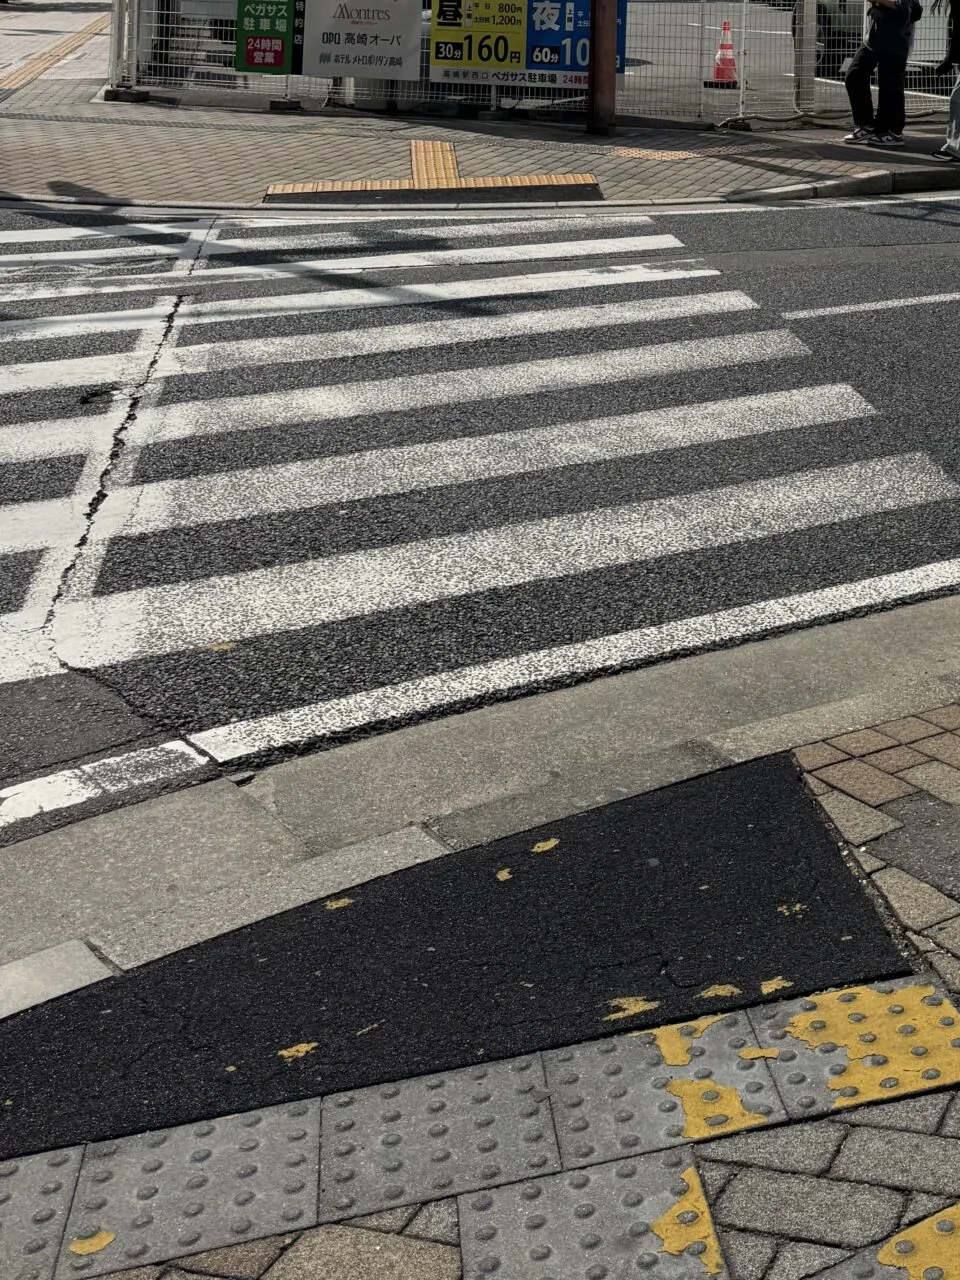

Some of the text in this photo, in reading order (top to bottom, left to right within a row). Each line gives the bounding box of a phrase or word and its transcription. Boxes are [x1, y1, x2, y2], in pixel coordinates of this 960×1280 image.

[244, 4, 288, 17] ペガサス
[333, 3, 391, 21] Montres
[498, 3, 523, 13] 800円
[491, 15, 522, 27] 1,200円
[532, 0, 562, 32] 夜
[243, 17, 287, 33] 駐車場
[247, 38, 282, 52] 24時間
[438, 34, 521, 64] 30分 160円
[253, 51, 276, 64] 営業
[532, 47, 560, 63] 60分
[492, 72, 557, 84] ペガサス駐車場
